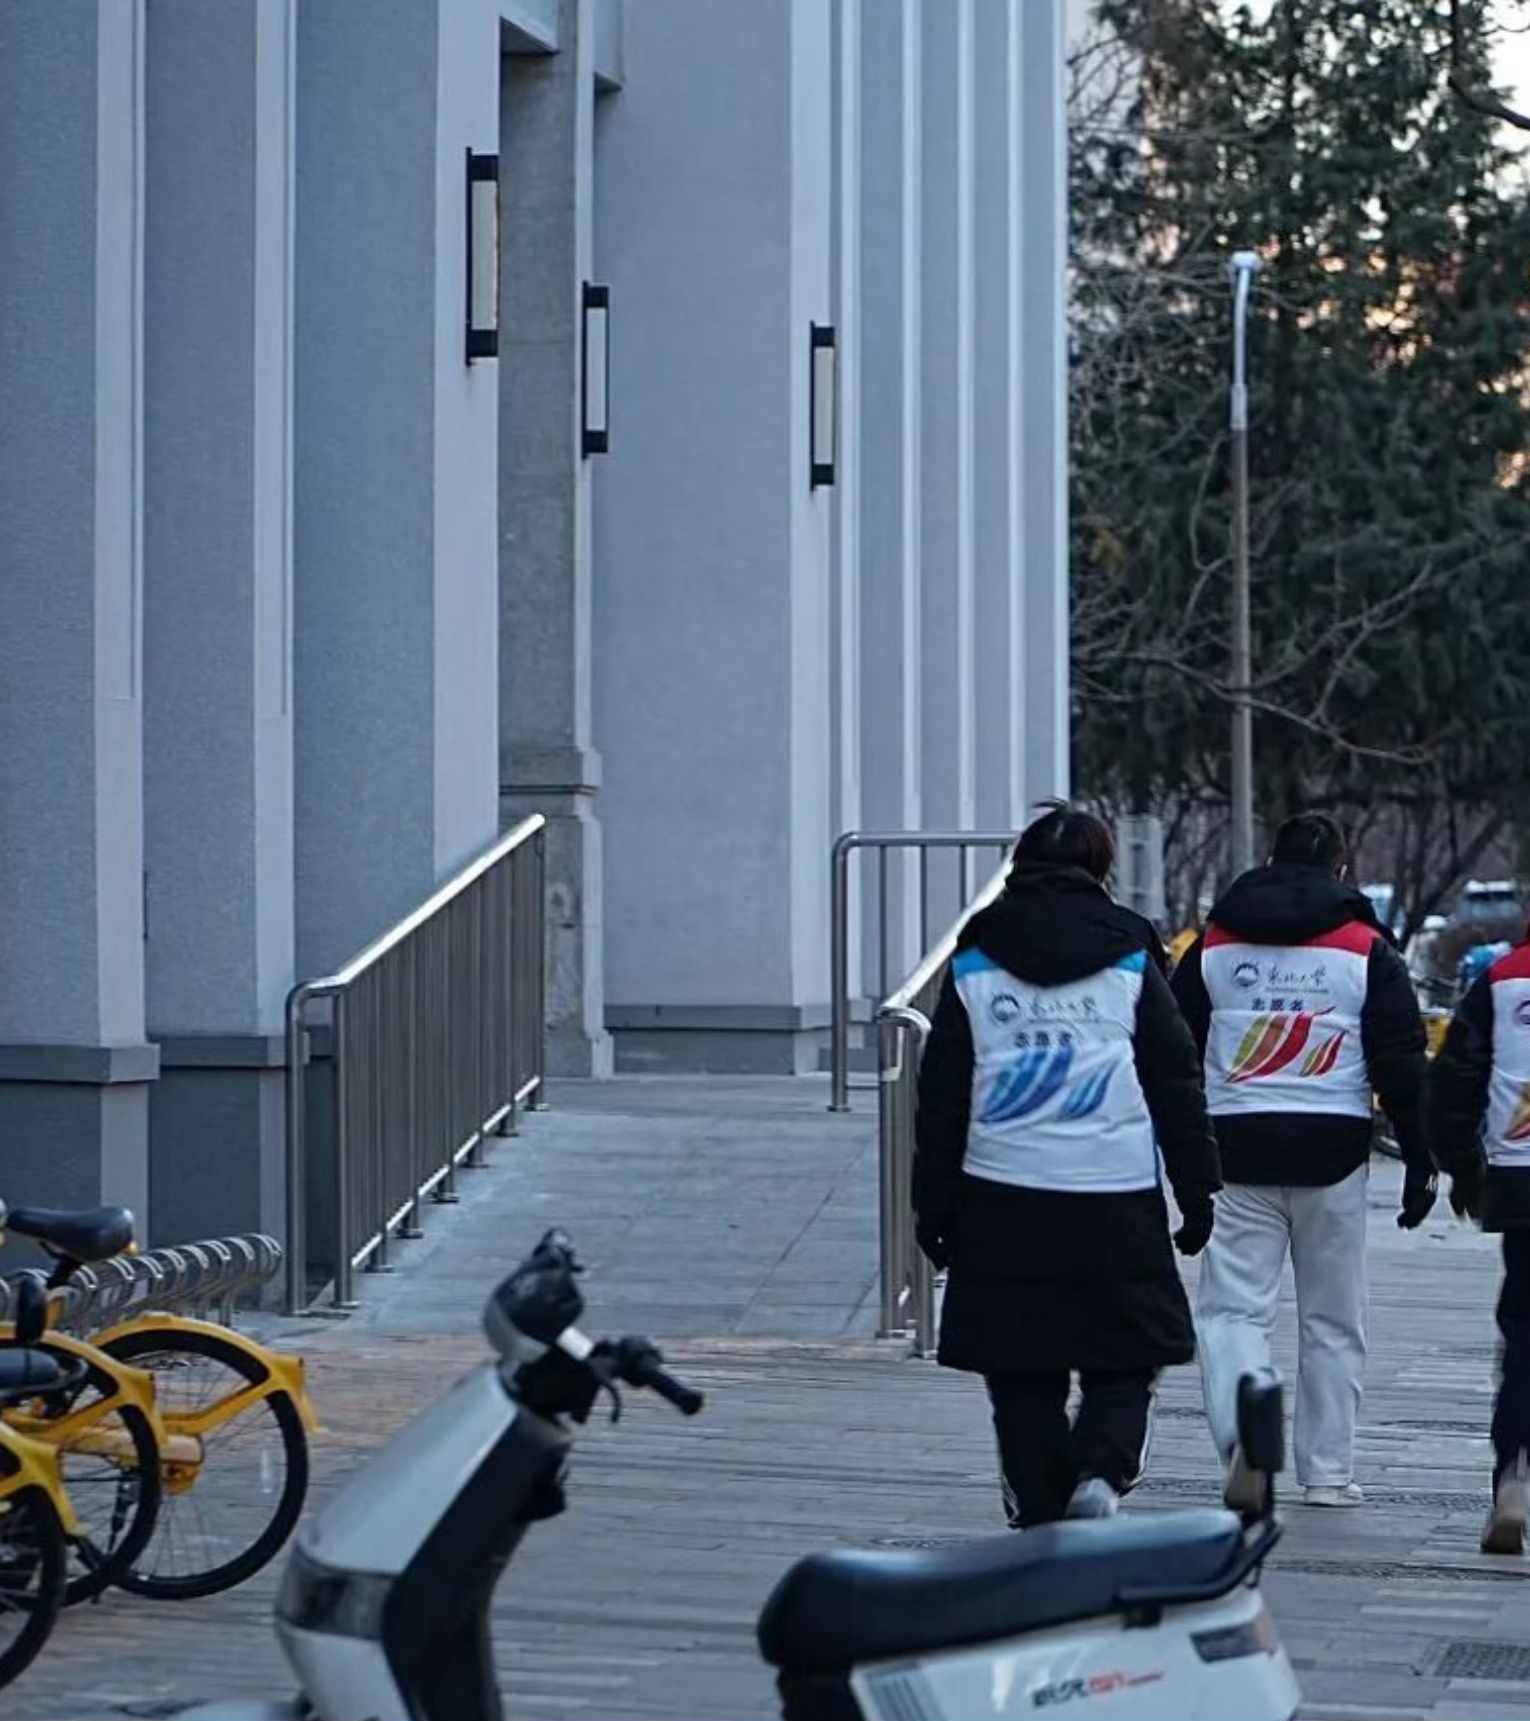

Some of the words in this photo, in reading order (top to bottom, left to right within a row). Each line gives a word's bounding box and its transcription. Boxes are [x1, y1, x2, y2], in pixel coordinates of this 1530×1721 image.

[1251, 997, 1304, 1012] 志愿者
[1013, 1030, 1074, 1049] 志愿者
